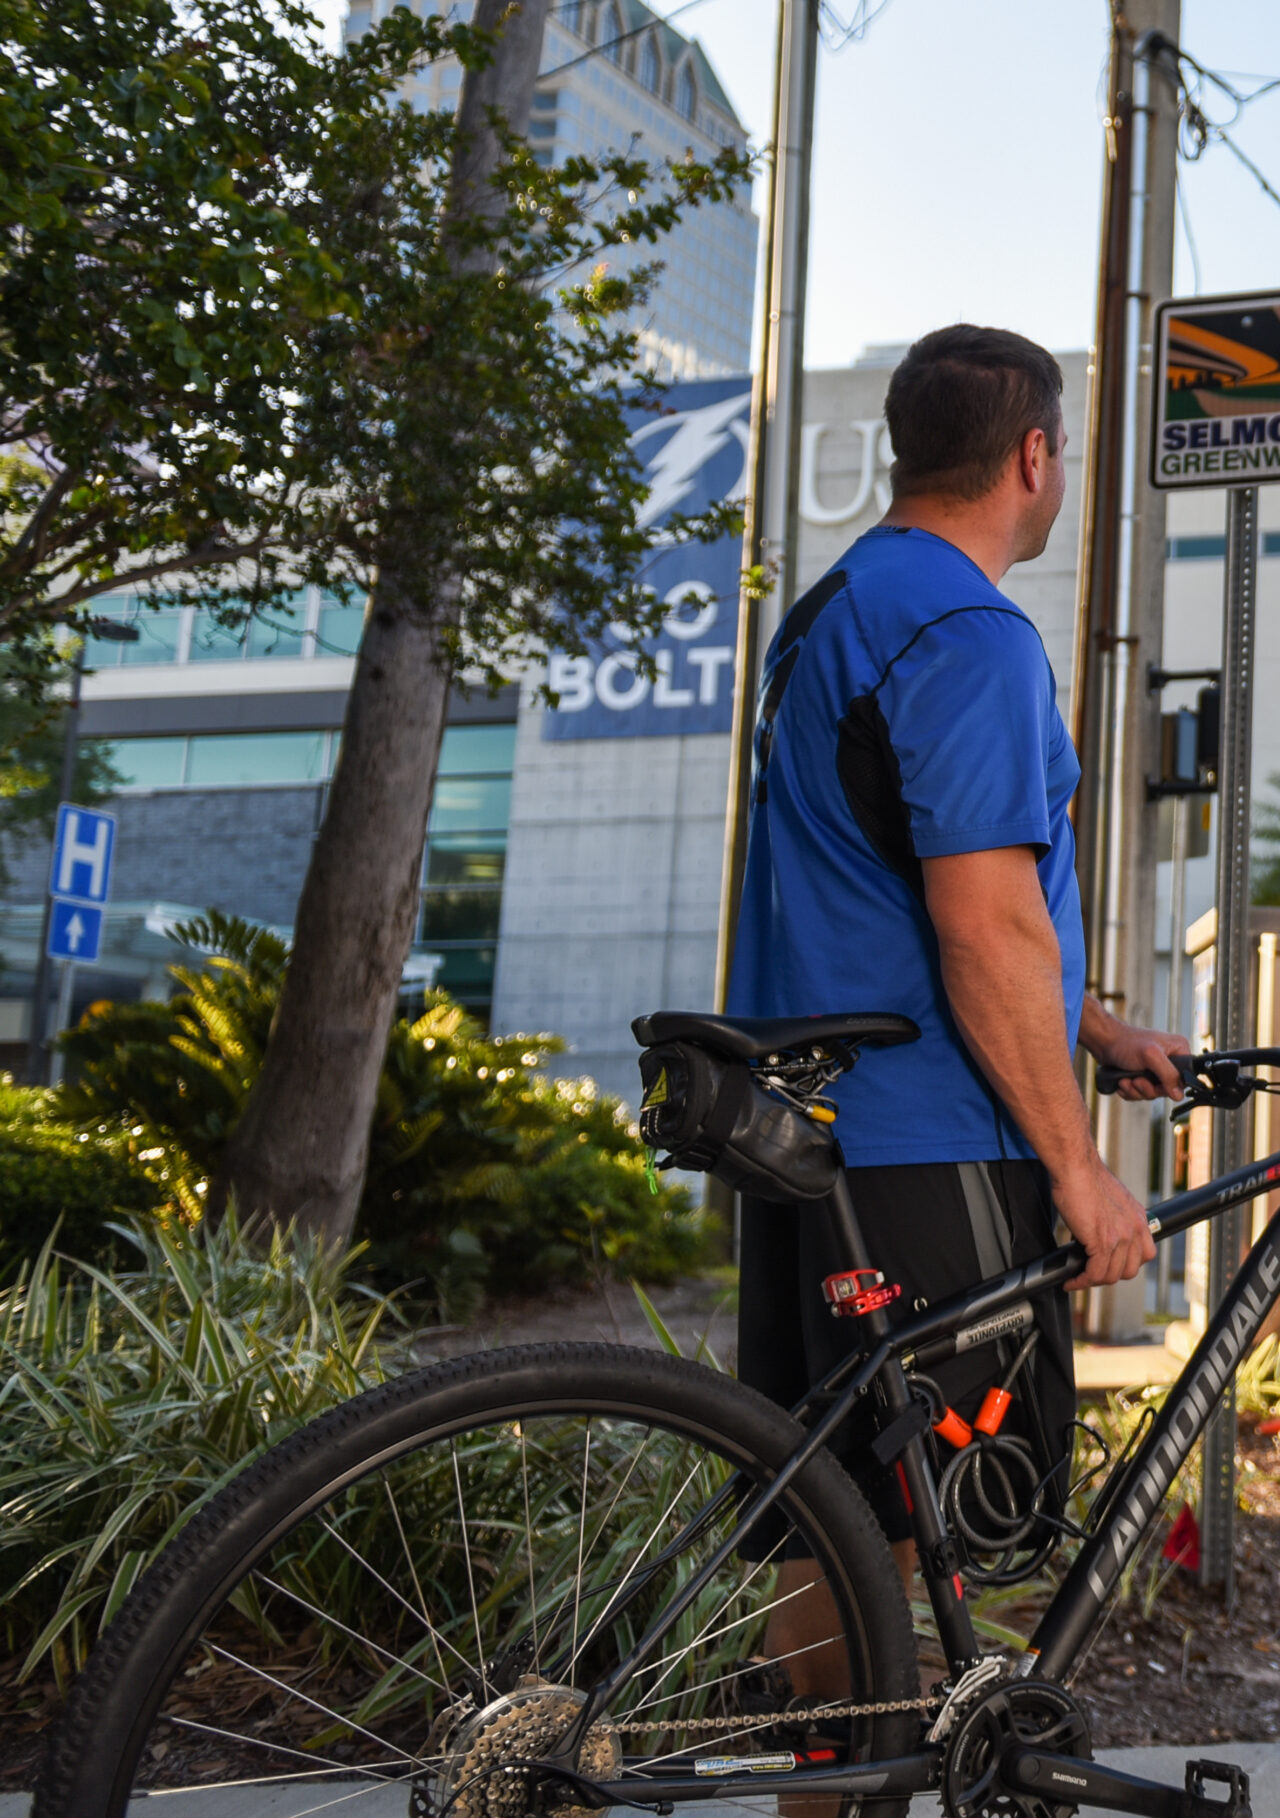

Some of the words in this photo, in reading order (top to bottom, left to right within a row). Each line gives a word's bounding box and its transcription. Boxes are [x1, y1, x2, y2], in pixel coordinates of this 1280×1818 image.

[548, 645, 738, 713] BOLT
[57, 812, 109, 898] H
[966, 1312, 1024, 1345] KRYPTONITE
[1051, 1771, 1088, 1787] SHIMANO
